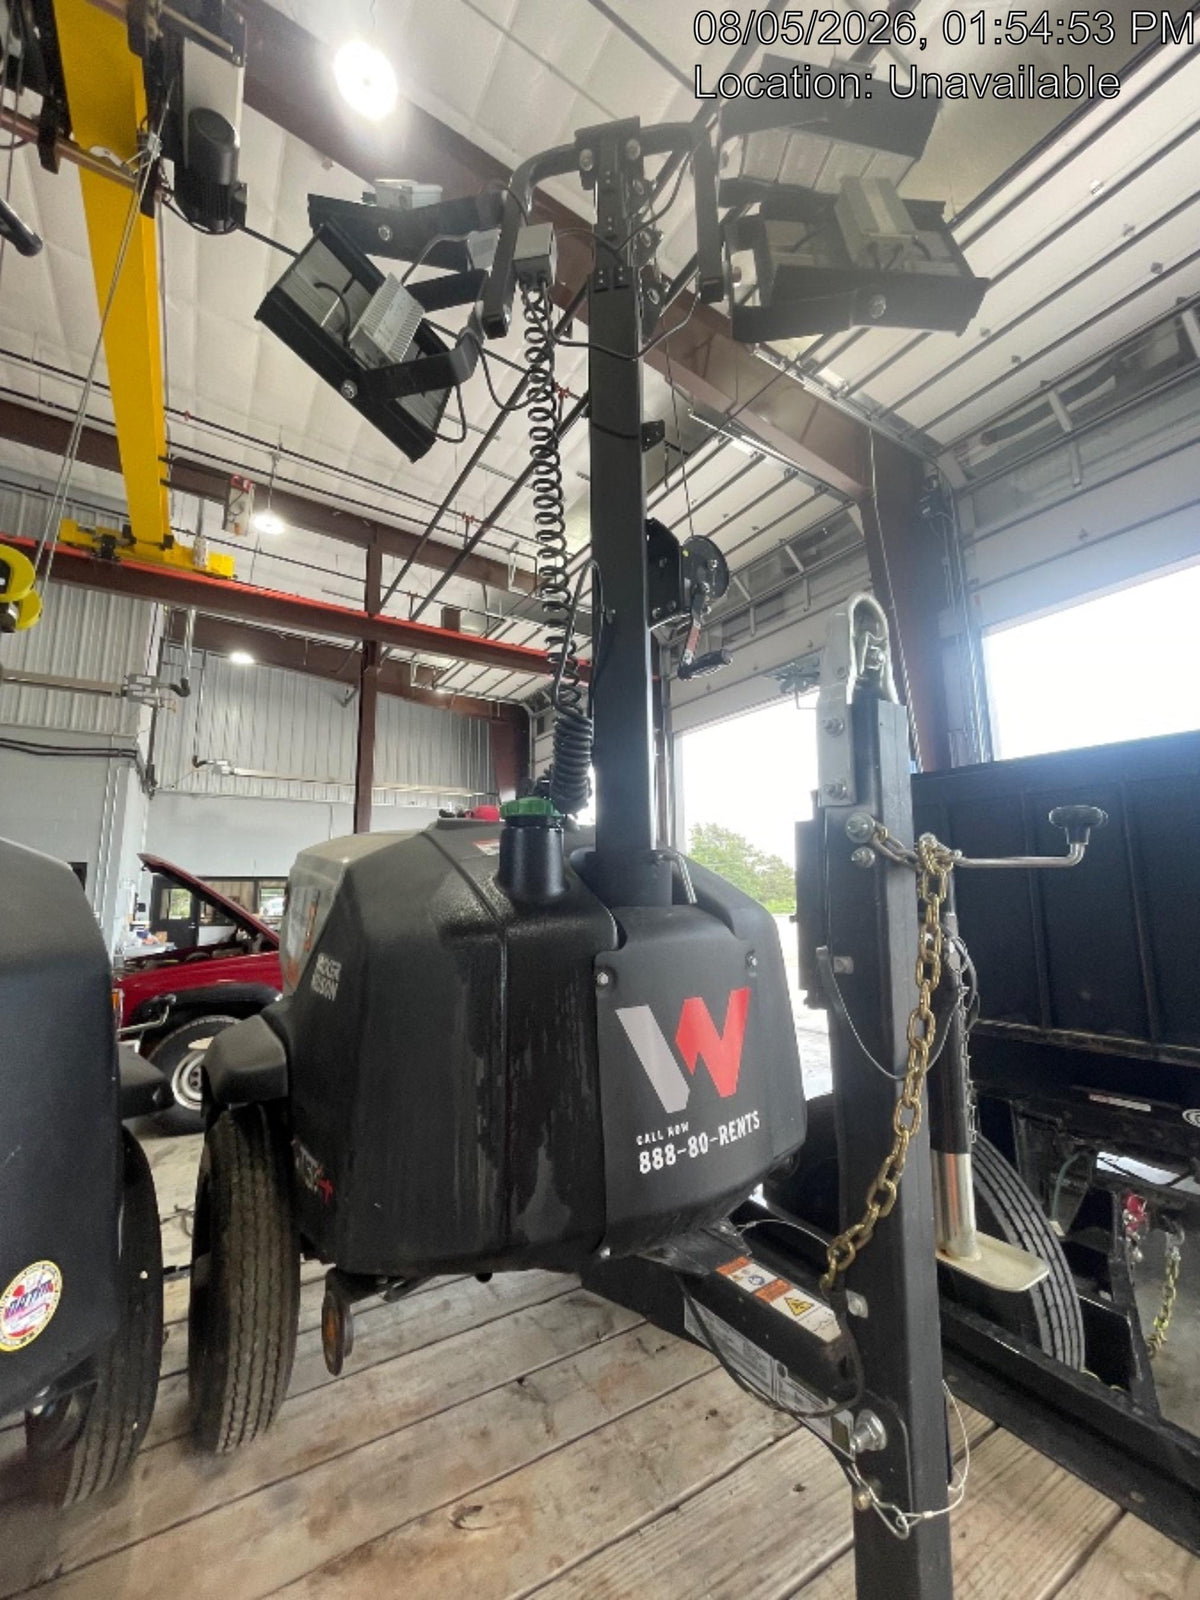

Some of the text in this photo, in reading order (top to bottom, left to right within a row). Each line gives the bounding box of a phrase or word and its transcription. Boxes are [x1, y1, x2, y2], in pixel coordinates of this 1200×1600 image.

[636, 1121, 689, 1146] CALL NOW
[639, 1110, 760, 1174] 888-80-RENTS
